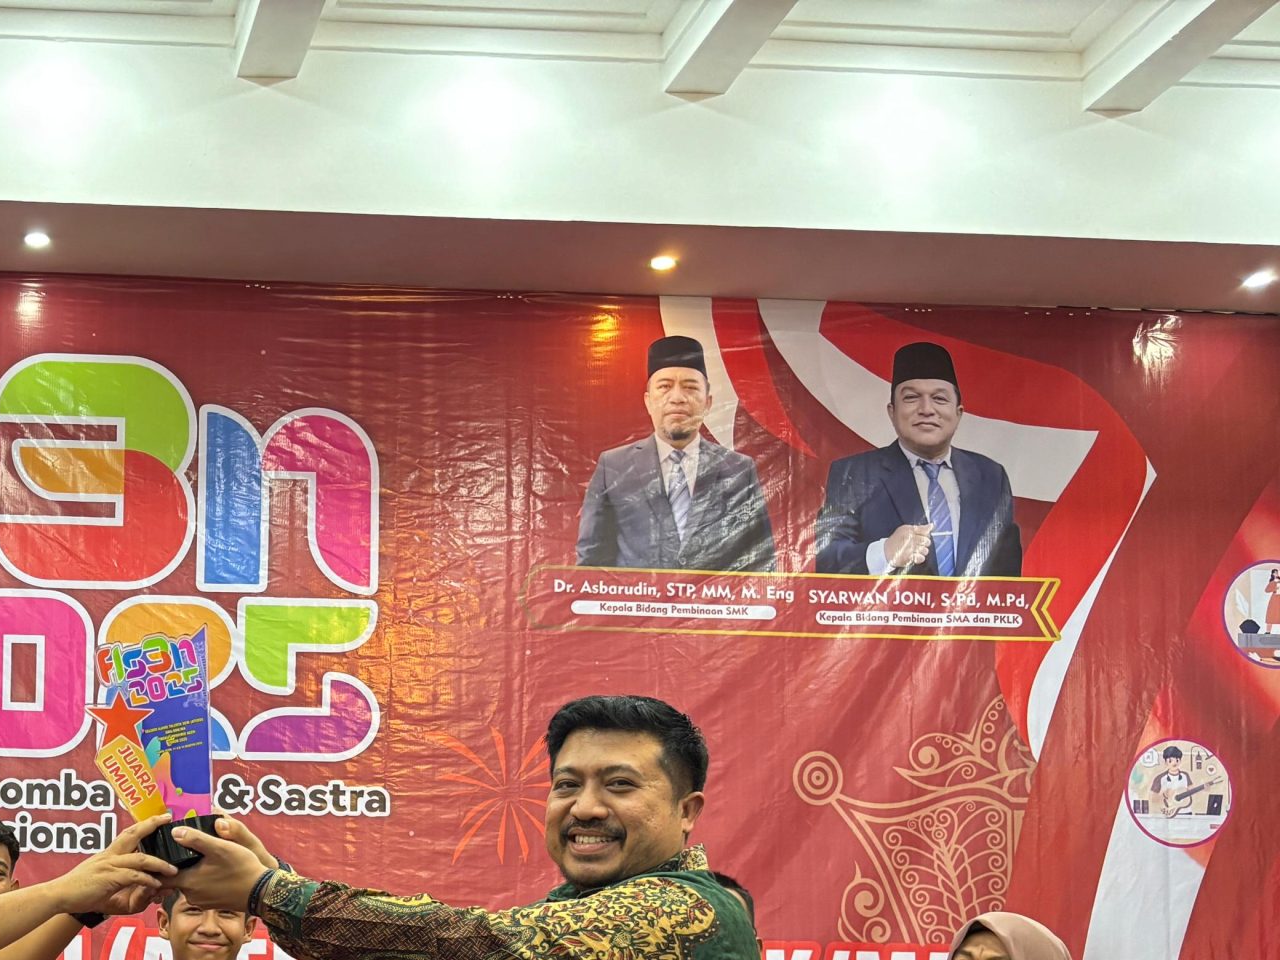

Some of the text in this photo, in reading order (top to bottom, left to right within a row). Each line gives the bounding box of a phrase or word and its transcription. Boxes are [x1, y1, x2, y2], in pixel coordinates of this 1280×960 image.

[554, 579, 794, 602] Dr. Asbarudin, STP, MM, M. Eng
[809, 590, 1029, 610] SYARWAN JONI, S.Pd, M.Pd,
[599, 603, 748, 616] Kepala Bidang Pembinaan SMK
[819, 612, 1020, 625] Kepala Bidang Pembinaan SMA dan PKLK
[102, 755, 142, 807] UMUM
[118, 744, 158, 798] JUARA
[217, 777, 250, 813] &
[260, 778, 387, 813] Sastra
